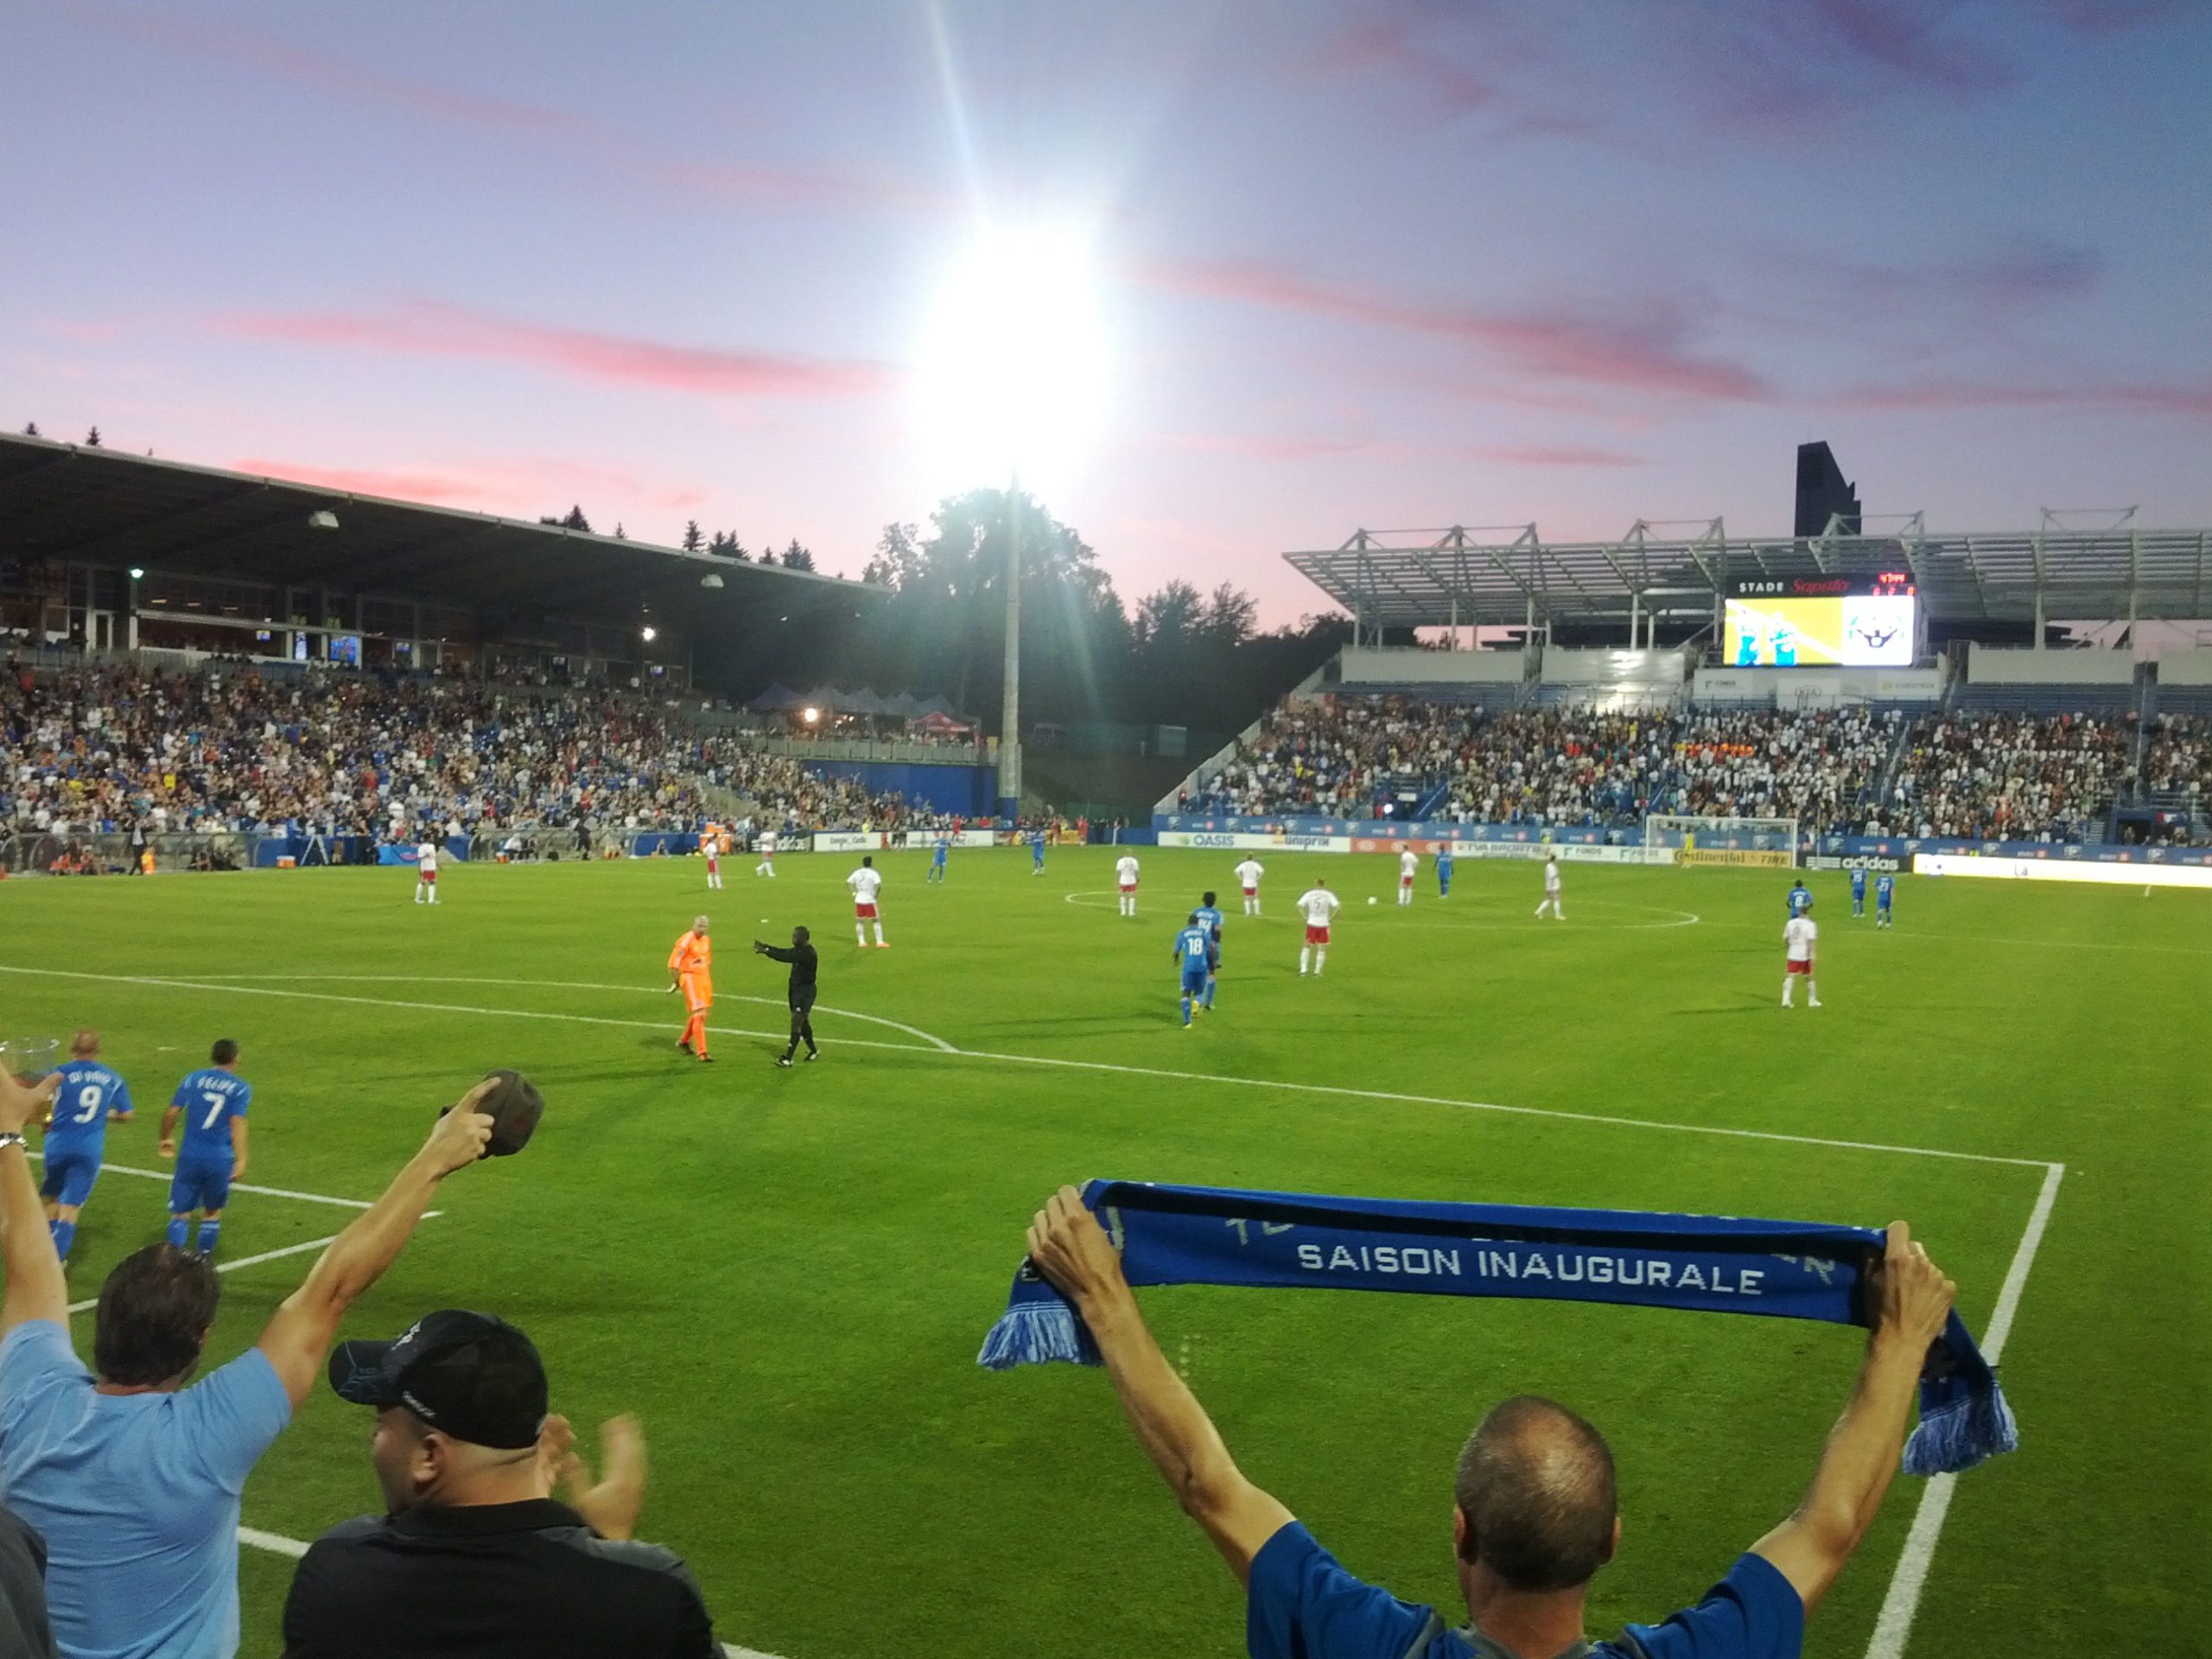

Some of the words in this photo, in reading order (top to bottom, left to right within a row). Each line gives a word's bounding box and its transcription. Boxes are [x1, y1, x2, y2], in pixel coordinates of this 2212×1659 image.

[1738, 582, 1784, 594] STADE
[1791, 578, 1852, 595] Saputo
[1193, 835, 1234, 846] OASIS
[1285, 836, 1330, 850] uniprix
[1841, 855, 1899, 871] adidas
[1187, 938, 1204, 956] 18
[73, 1085, 103, 1124] 9
[201, 1091, 226, 1130] 7
[1297, 1244, 1461, 1275] SAISON
[1478, 1250, 1764, 1295] INAUGURALE
